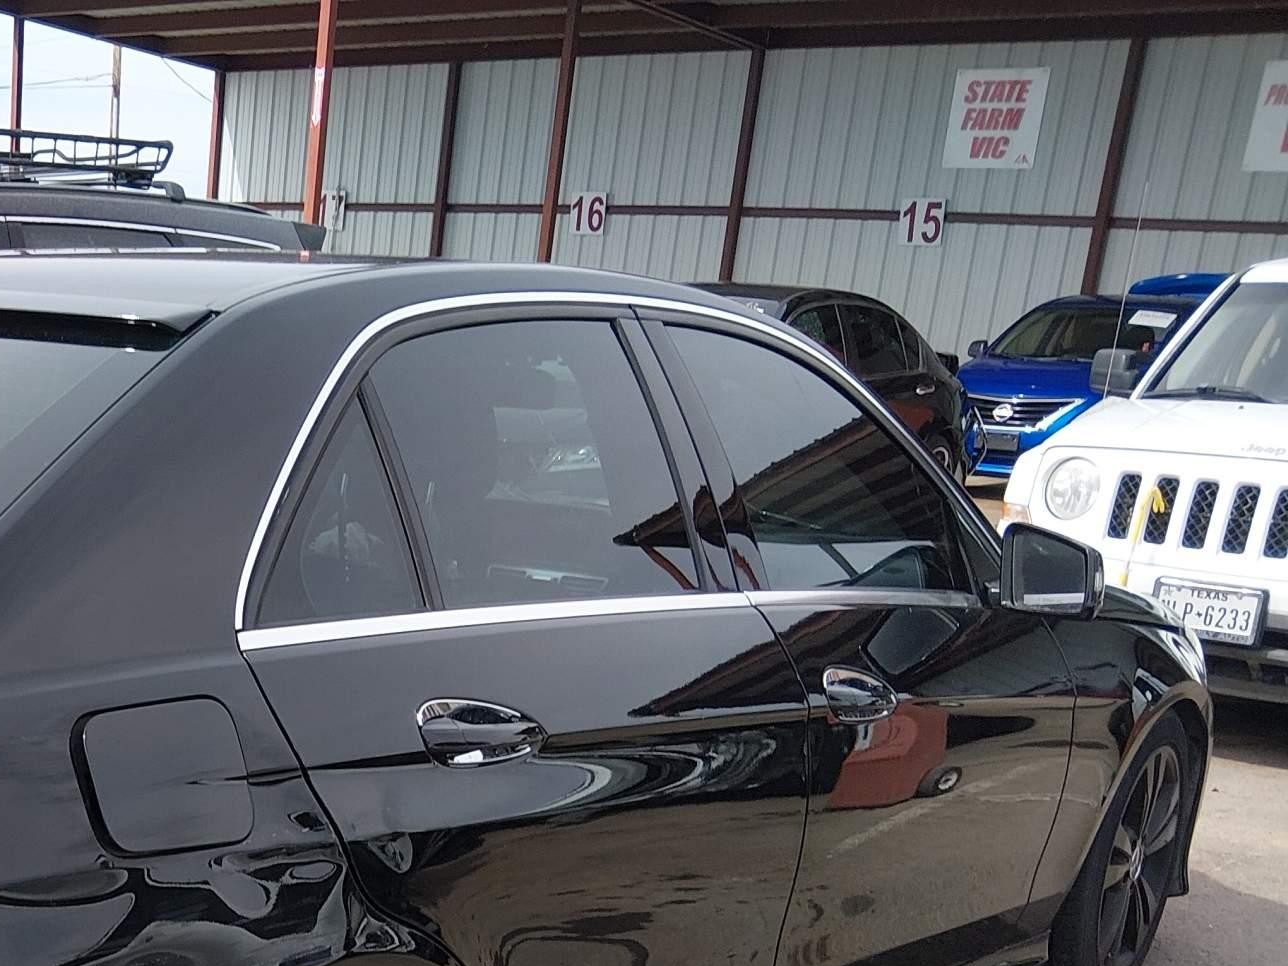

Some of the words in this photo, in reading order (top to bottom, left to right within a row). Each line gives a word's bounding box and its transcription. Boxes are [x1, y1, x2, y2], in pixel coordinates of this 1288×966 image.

[964, 79, 1033, 104] STATE
[961, 107, 1026, 132] FARM
[969, 136, 1010, 160] VIC
[572, 195, 604, 232] 16
[903, 200, 943, 244] 15
[1191, 587, 1229, 602] TEXAS
